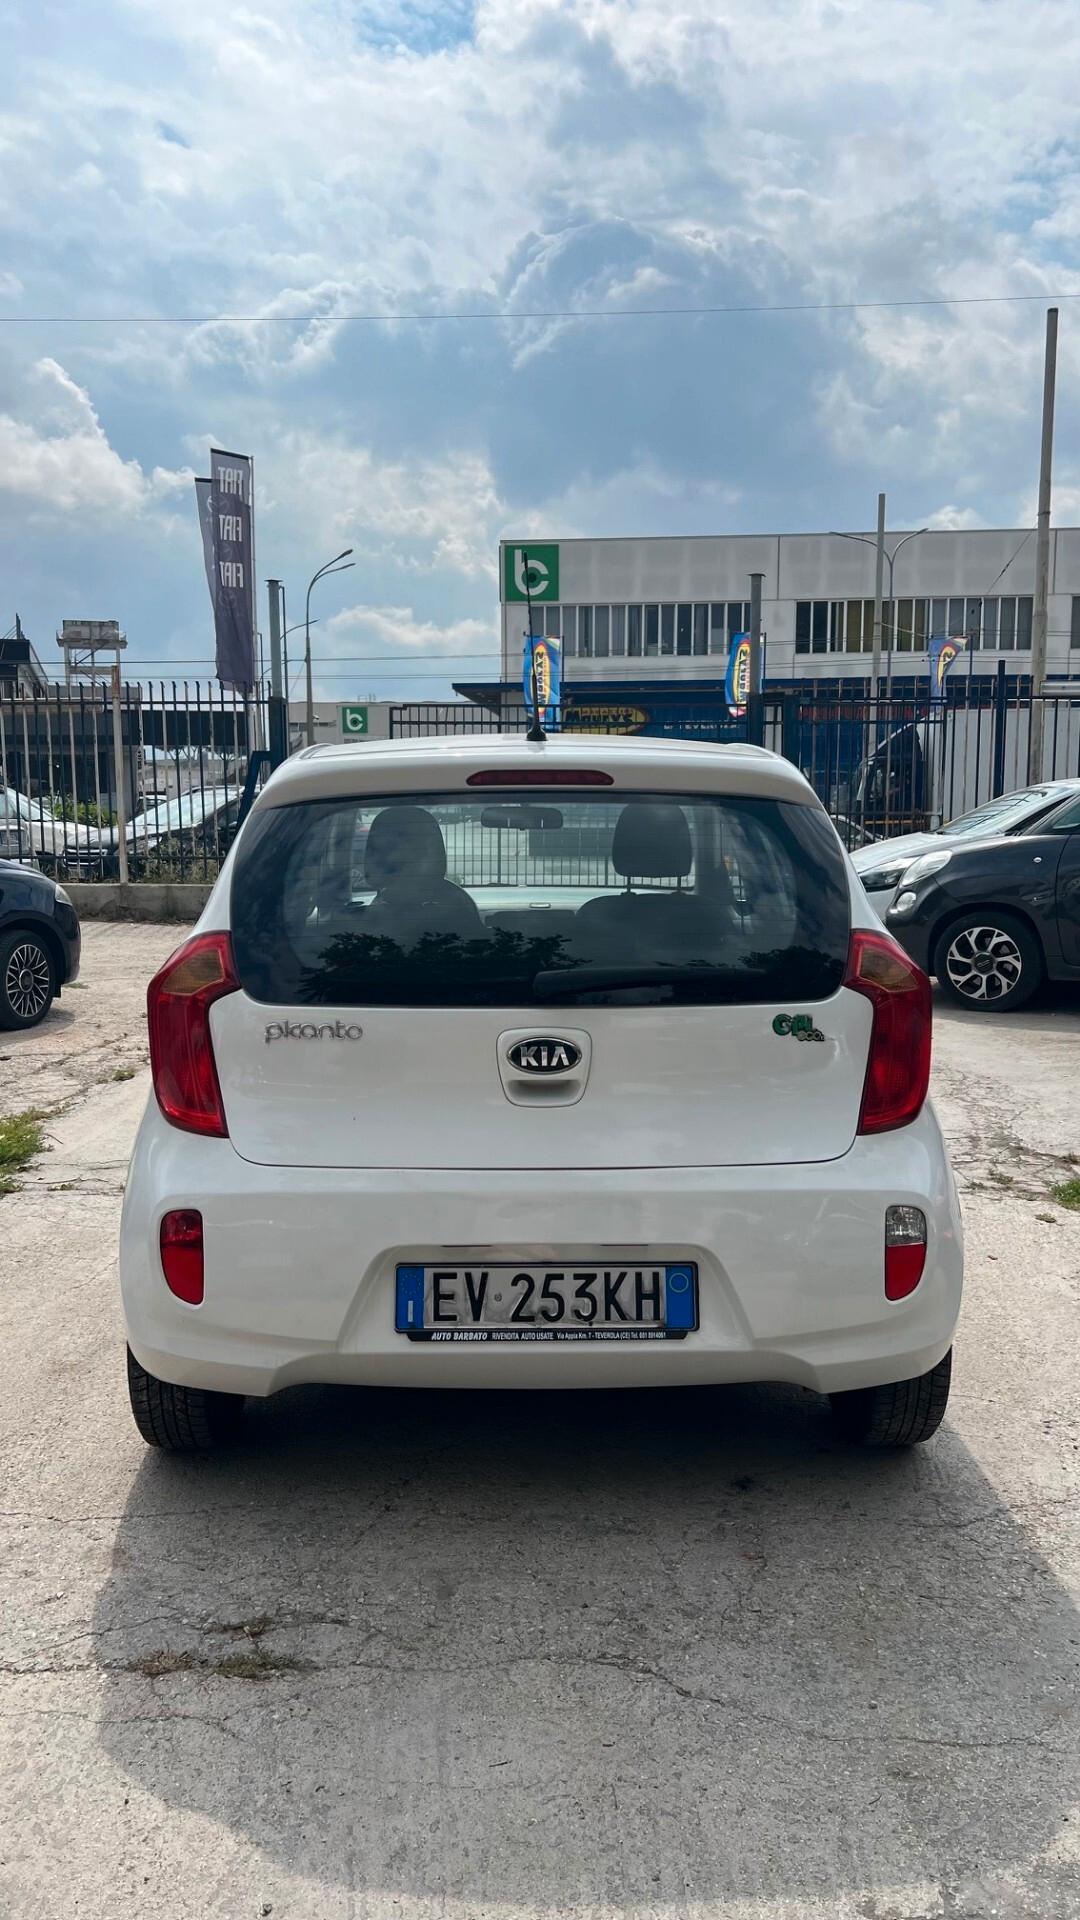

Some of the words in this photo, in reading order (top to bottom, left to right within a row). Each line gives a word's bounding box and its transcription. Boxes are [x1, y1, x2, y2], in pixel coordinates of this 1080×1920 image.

[264, 1020, 363, 1045] picanto
[520, 1046, 570, 1067] KIA
[432, 1271, 489, 1322] EV
[510, 1271, 661, 1322] 253KH
[431, 1331, 451, 1341] AUTO
[453, 1331, 488, 1341] BARBATO
[491, 1331, 519, 1340] RIVENDITA
[521, 1331, 535, 1340] AUTO
[536, 1331, 554, 1340] USATE
[556, 1331, 565, 1340] Via
[595, 1331, 620, 1339] TEVEROLA
